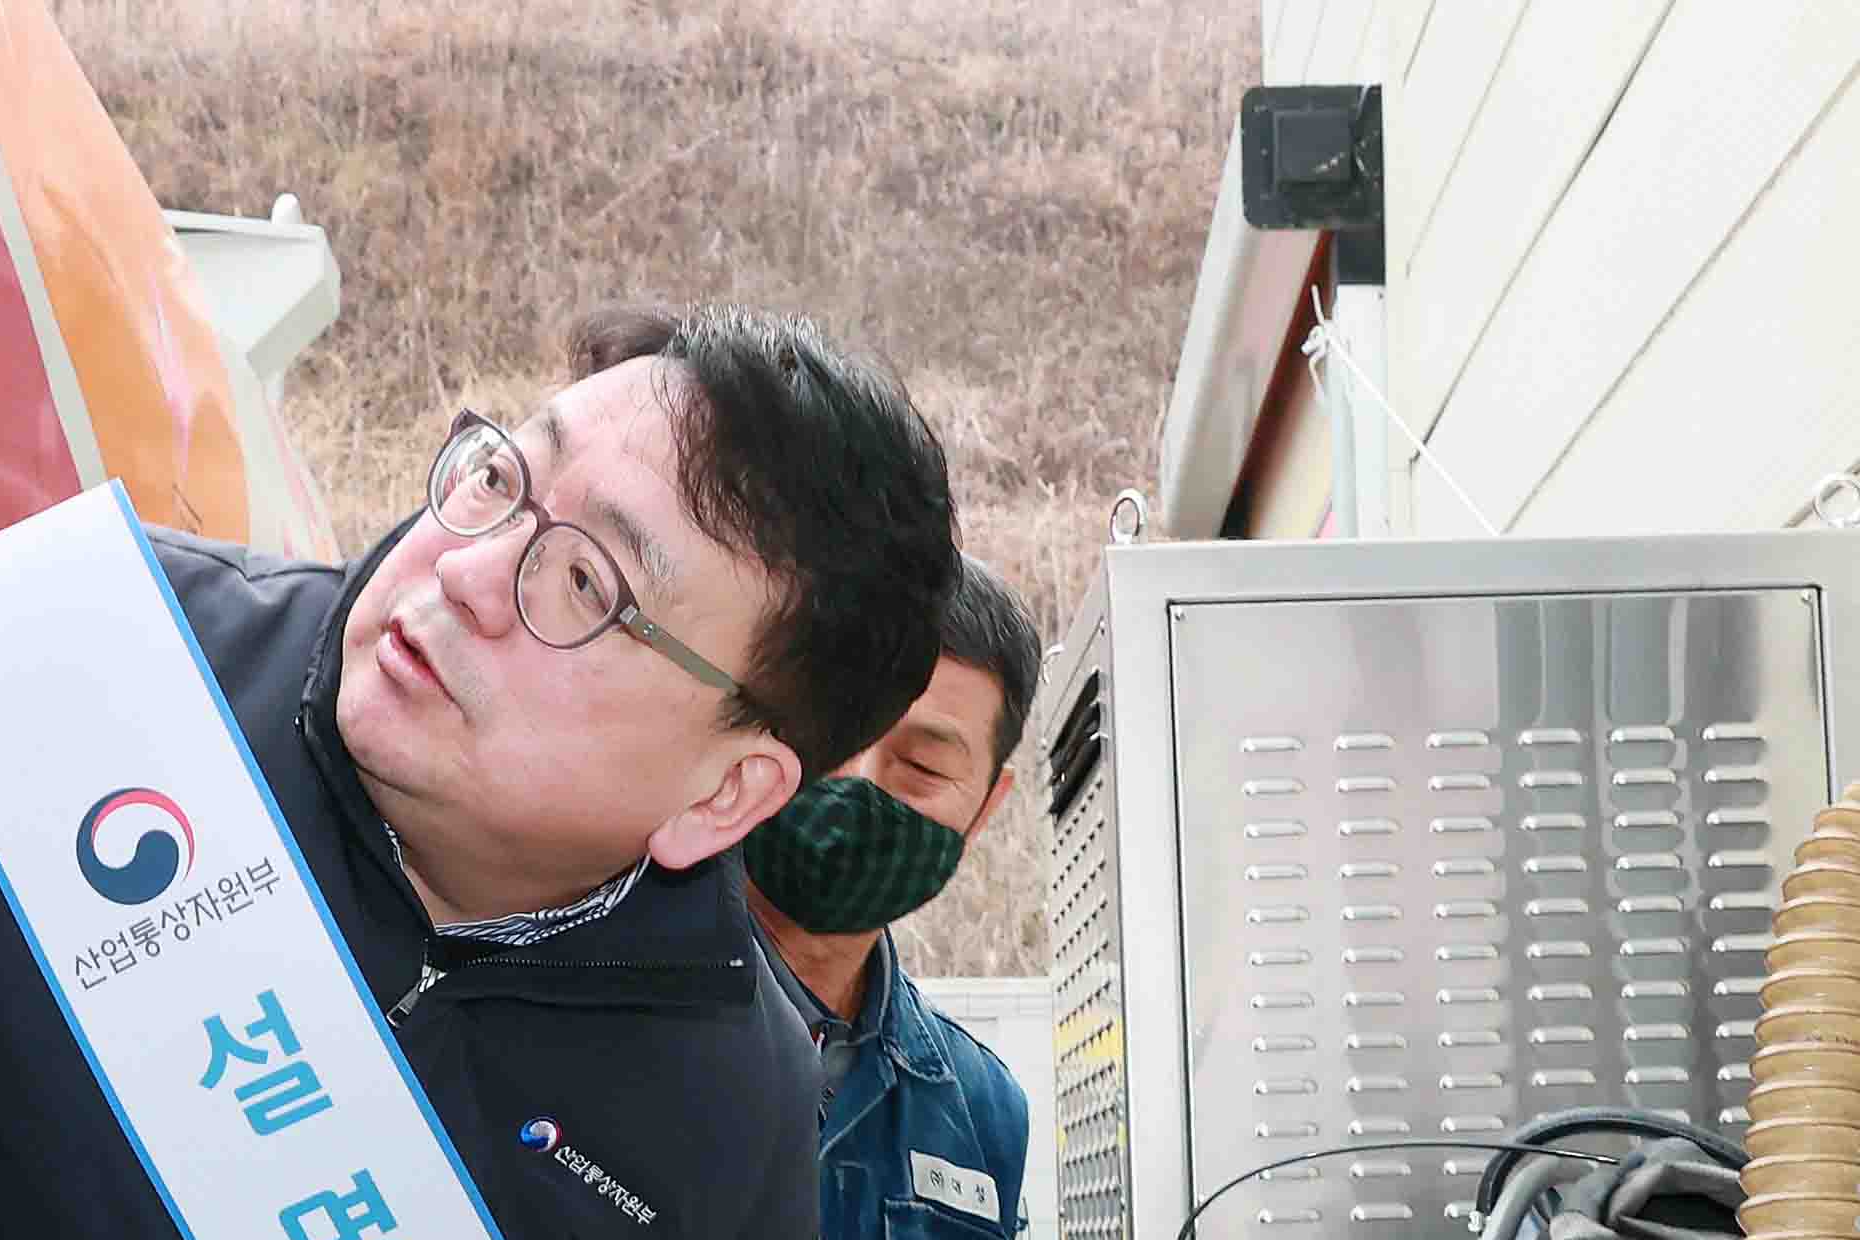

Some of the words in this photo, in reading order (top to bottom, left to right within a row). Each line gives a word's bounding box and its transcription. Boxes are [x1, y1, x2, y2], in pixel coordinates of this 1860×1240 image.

[72, 855, 283, 992] 산업통상자원부
[198, 987, 334, 1138] 설
[553, 1145, 658, 1225] 산업통상자원부
